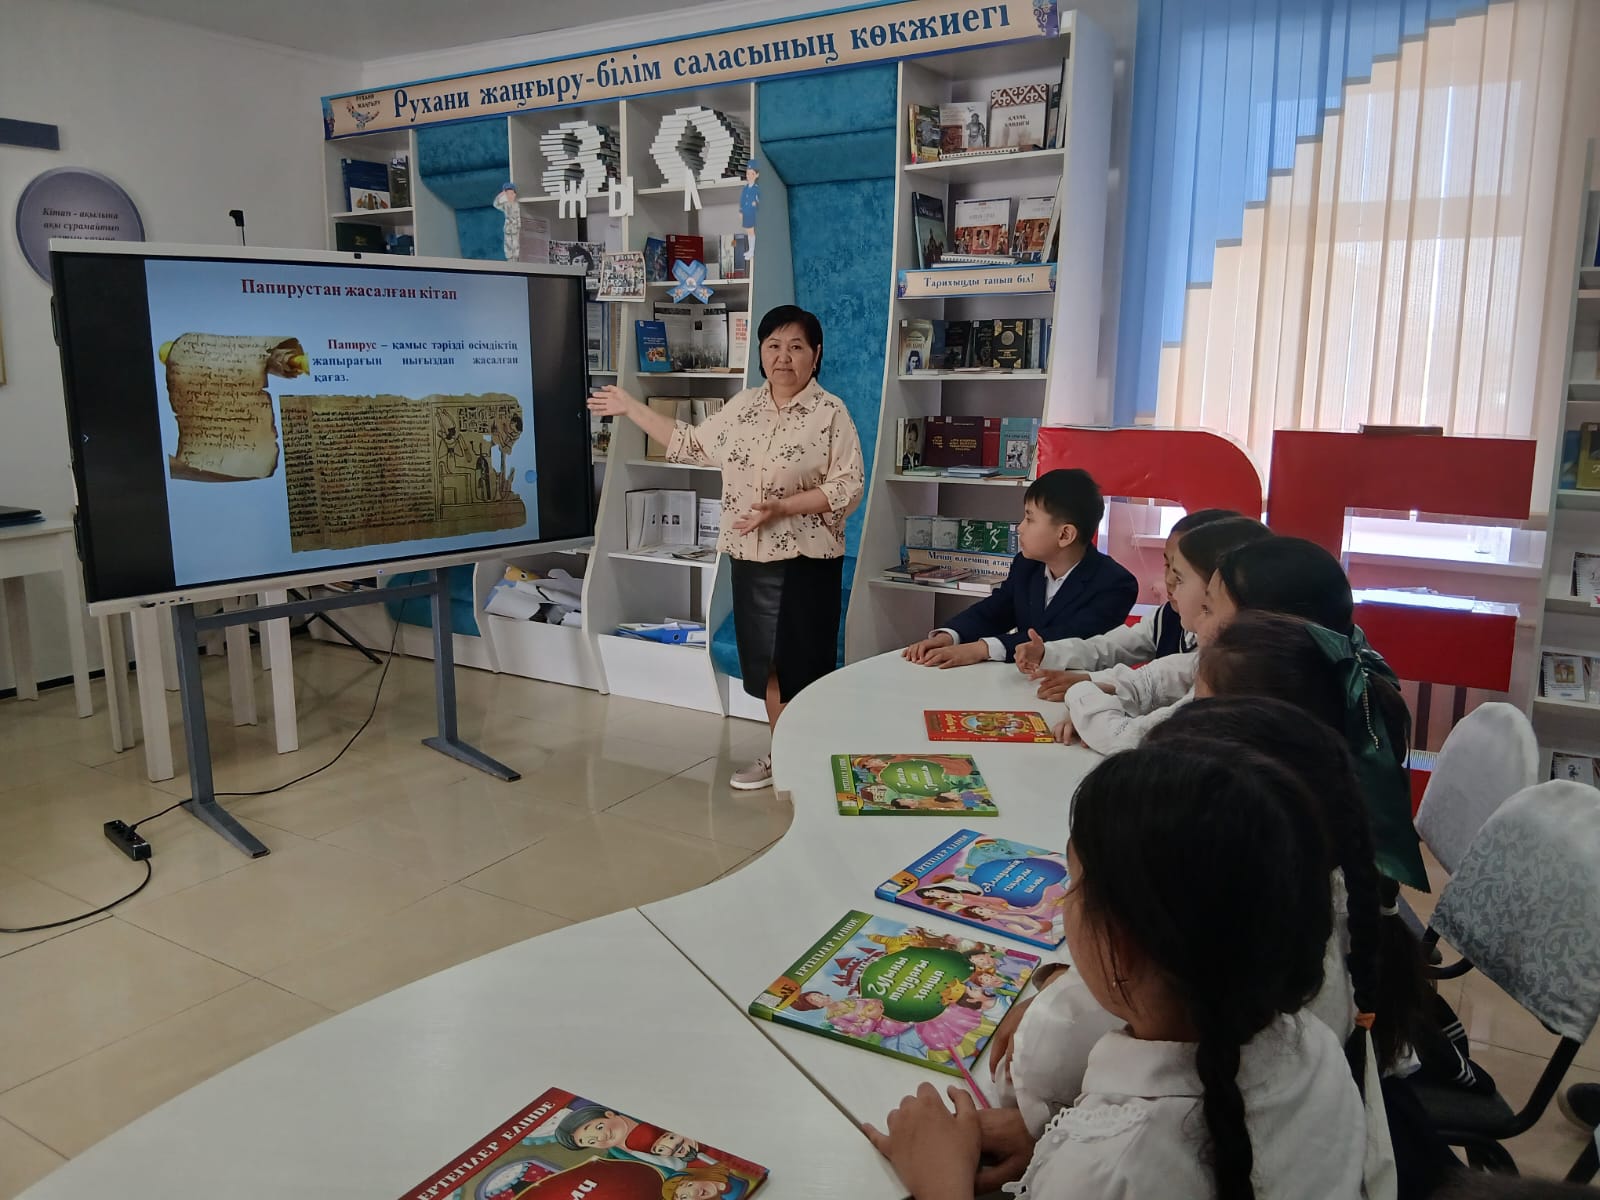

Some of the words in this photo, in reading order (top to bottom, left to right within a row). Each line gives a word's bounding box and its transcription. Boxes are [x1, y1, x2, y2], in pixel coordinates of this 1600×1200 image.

[393, 88, 470, 122] Рухани
[479, 53, 662, 109] жаңғыру-білім
[673, 31, 836, 76] саласының
[850, 3, 1011, 50] көкжиегі
[240, 278, 342, 299] Папирустан
[344, 286, 416, 299] жасалған
[419, 286, 457, 300] кітап
[327, 338, 377, 352] Папирус
[392, 341, 428, 352] қамыс
[431, 339, 465, 352] тәрізді
[312, 356, 382, 369] жапырағын
[472, 355, 519, 366] жасалған
[313, 372, 350, 384] қағаз.
[913, 970, 945, 1001] ханша
[417, 1141, 499, 1200] ЕРТЕГІЛЕР
[501, 1101, 556, 1141] ЕЛІНДЕ
